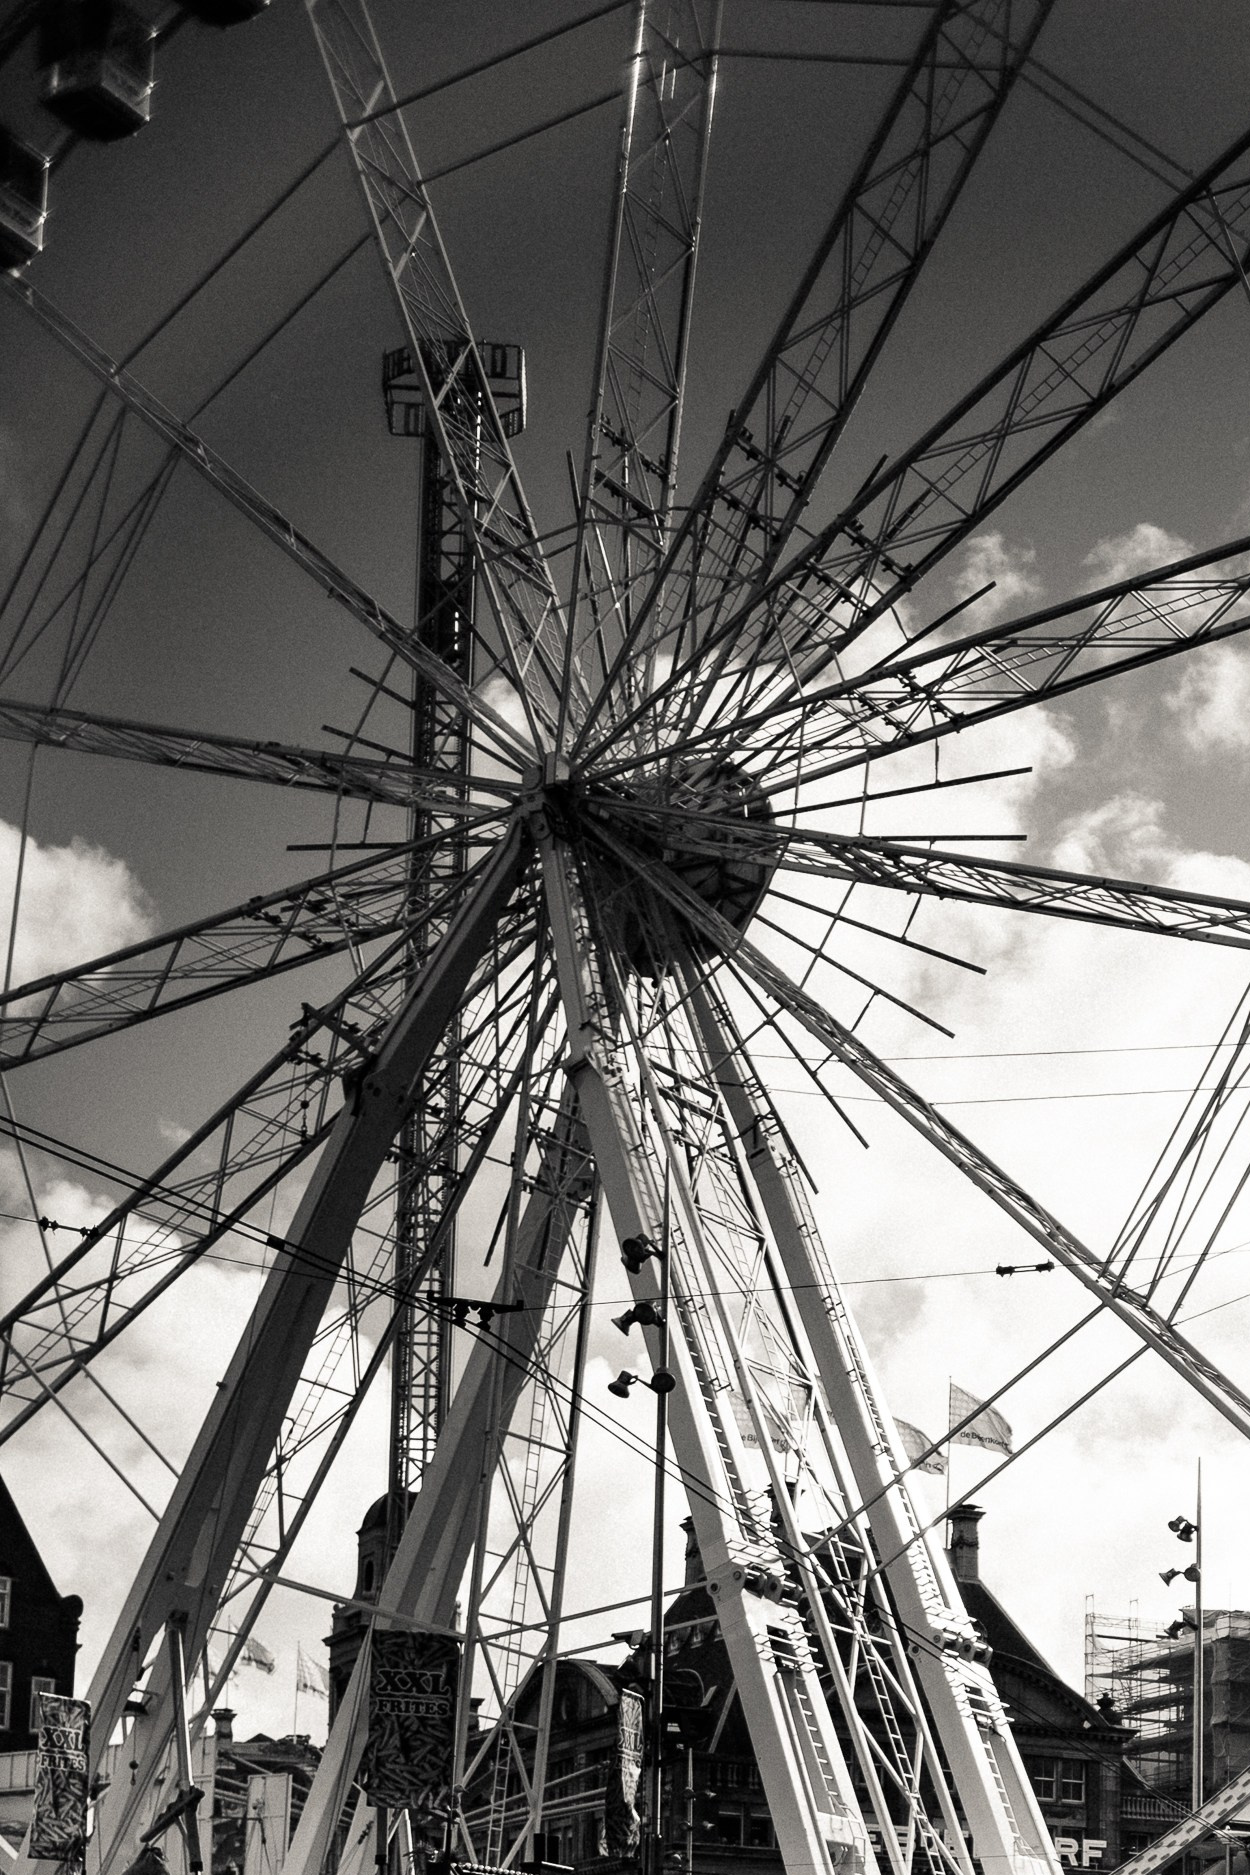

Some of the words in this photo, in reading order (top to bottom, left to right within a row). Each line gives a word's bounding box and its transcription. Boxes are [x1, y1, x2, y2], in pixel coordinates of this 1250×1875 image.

[377, 1668, 450, 1696] XXL
[378, 1700, 449, 1717] FRITES
[40, 1754, 85, 1771] FRITES
